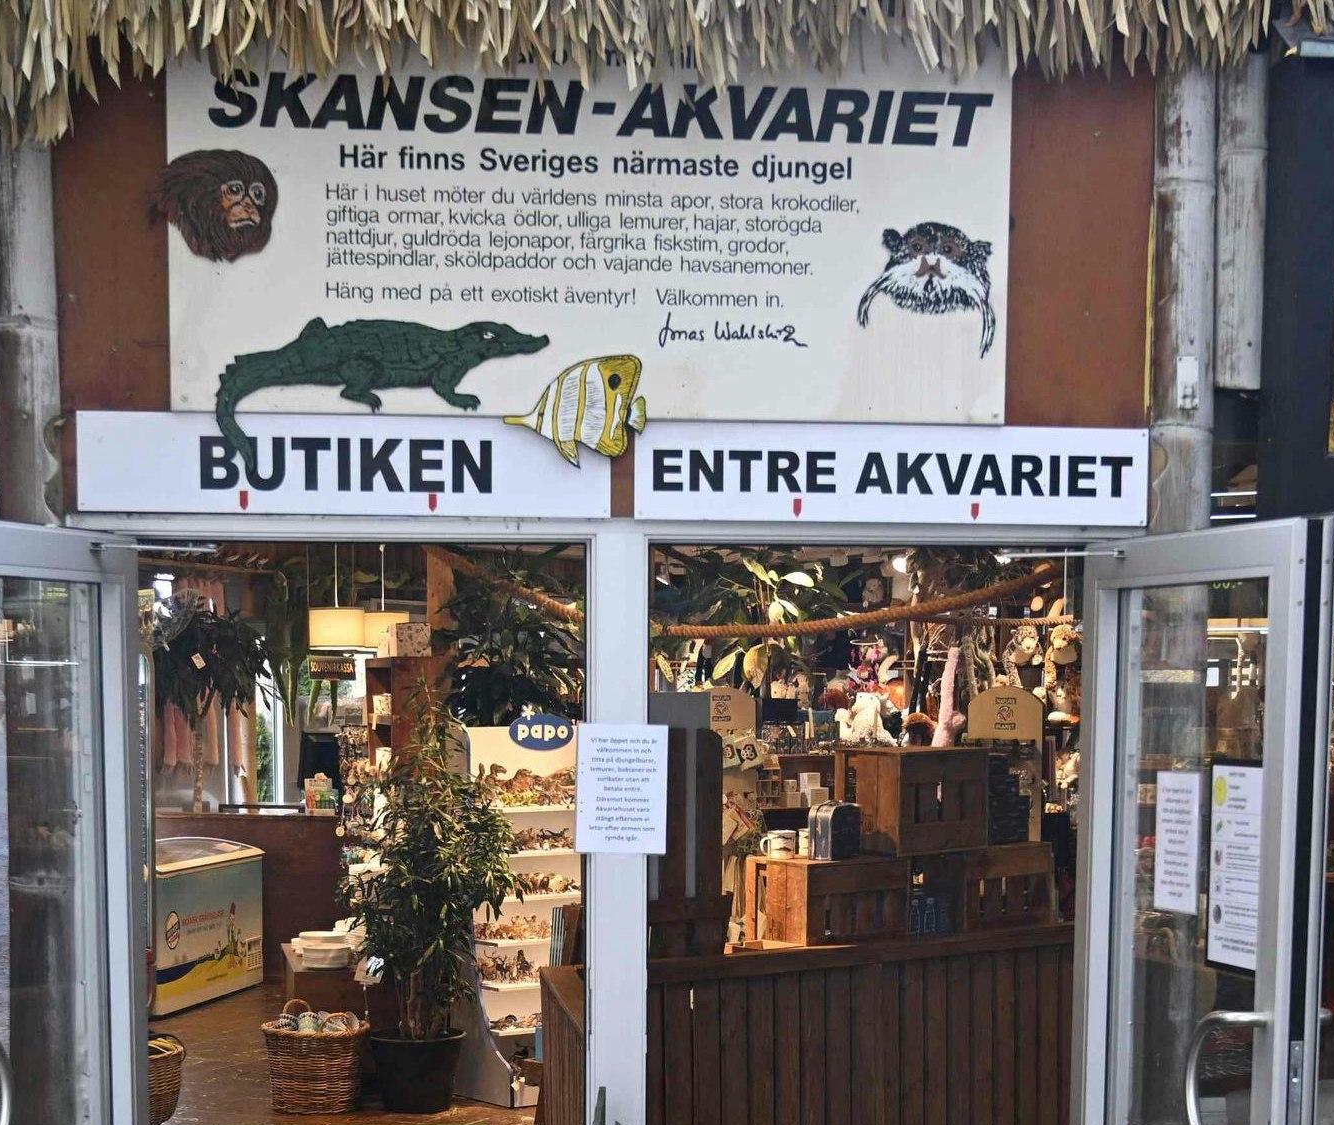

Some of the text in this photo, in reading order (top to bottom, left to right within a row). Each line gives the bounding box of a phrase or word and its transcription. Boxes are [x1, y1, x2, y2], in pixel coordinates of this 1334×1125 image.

[208, 69, 992, 147] SKANSEN-AKVARIET
[339, 144, 853, 184] Här finns Sveriges närmaste djungel
[325, 184, 860, 216] Här i huset möter du världens minsta apor, stora krokodiler,
[326, 206, 822, 237] giftiga ormar, kvicka ödlor, ulliga lemurer, hajar, storögda
[326, 230, 789, 257] nattdjur, guldröda lejonapor, färgrika fiskstim, grodor,
[326, 248, 814, 276] jättespindlar, sköldpaddor och vajande havsanemoner.
[325, 282, 784, 309] Häng med på ett exotiskt äventyr! Välkommen in.
[199, 436, 493, 493] BUTIKEN
[652, 449, 1134, 498] ENTRE AKVARIET
[517, 724, 568, 741] papo
